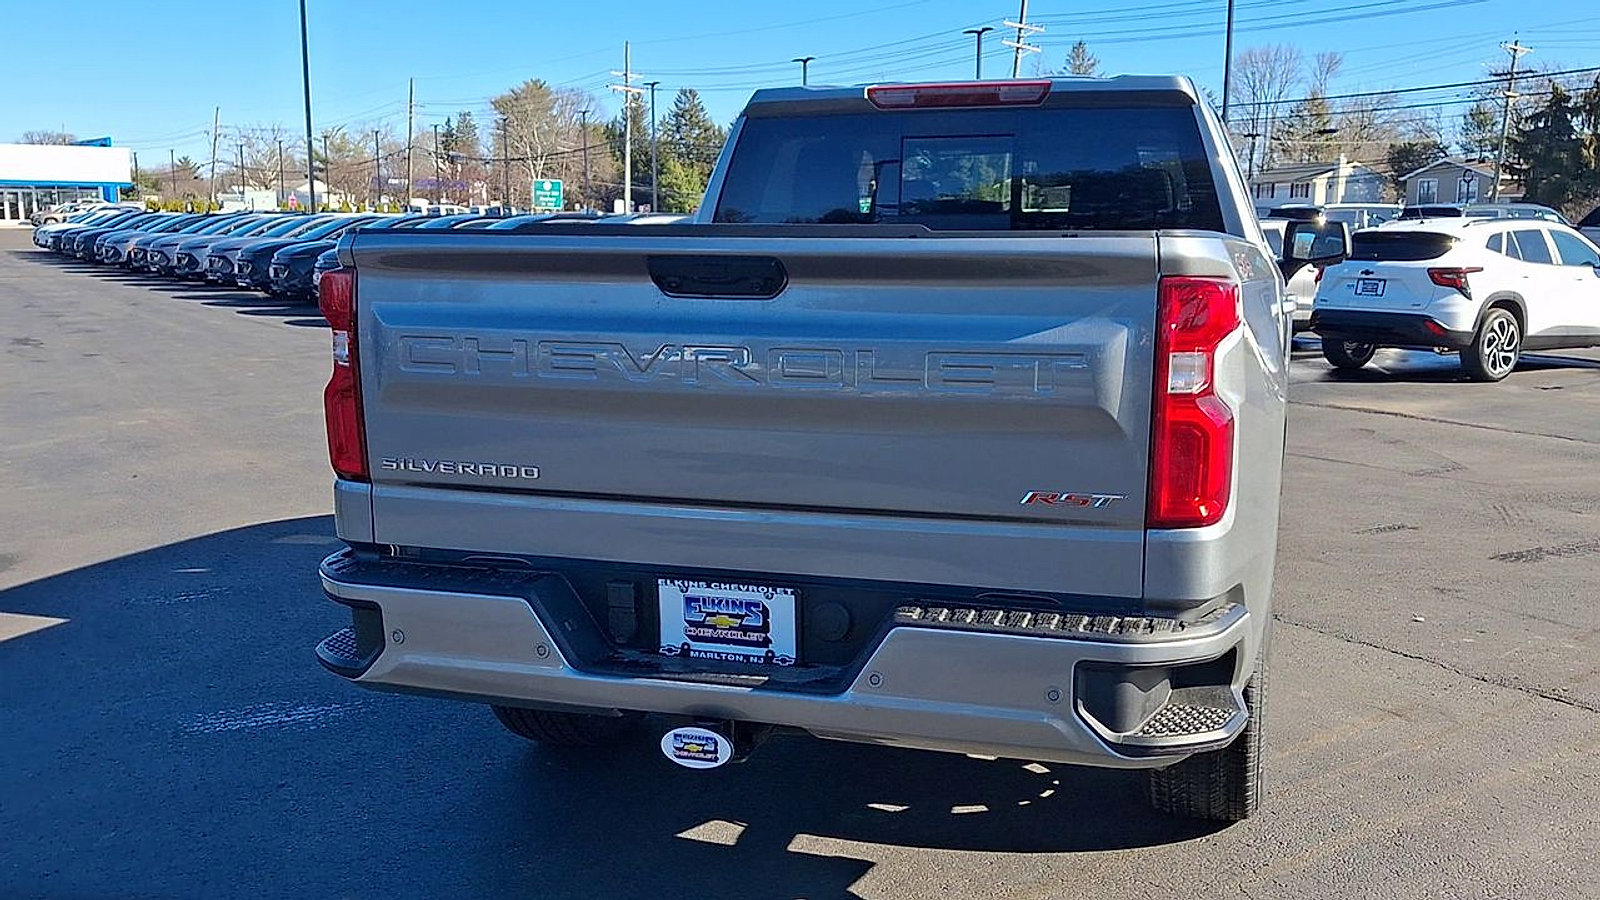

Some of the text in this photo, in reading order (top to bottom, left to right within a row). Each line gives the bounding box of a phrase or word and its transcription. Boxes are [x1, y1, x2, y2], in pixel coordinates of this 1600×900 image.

[399, 335, 1089, 396] CHEVROLET
[381, 457, 541, 480] SILVERADO
[1019, 489, 1127, 508] RST
[657, 578, 794, 595] ELKINS CHEVROLET
[683, 594, 763, 626] ELKINS
[684, 626, 766, 642] CHEVROLET
[690, 650, 764, 664] MARLTON, NJ
